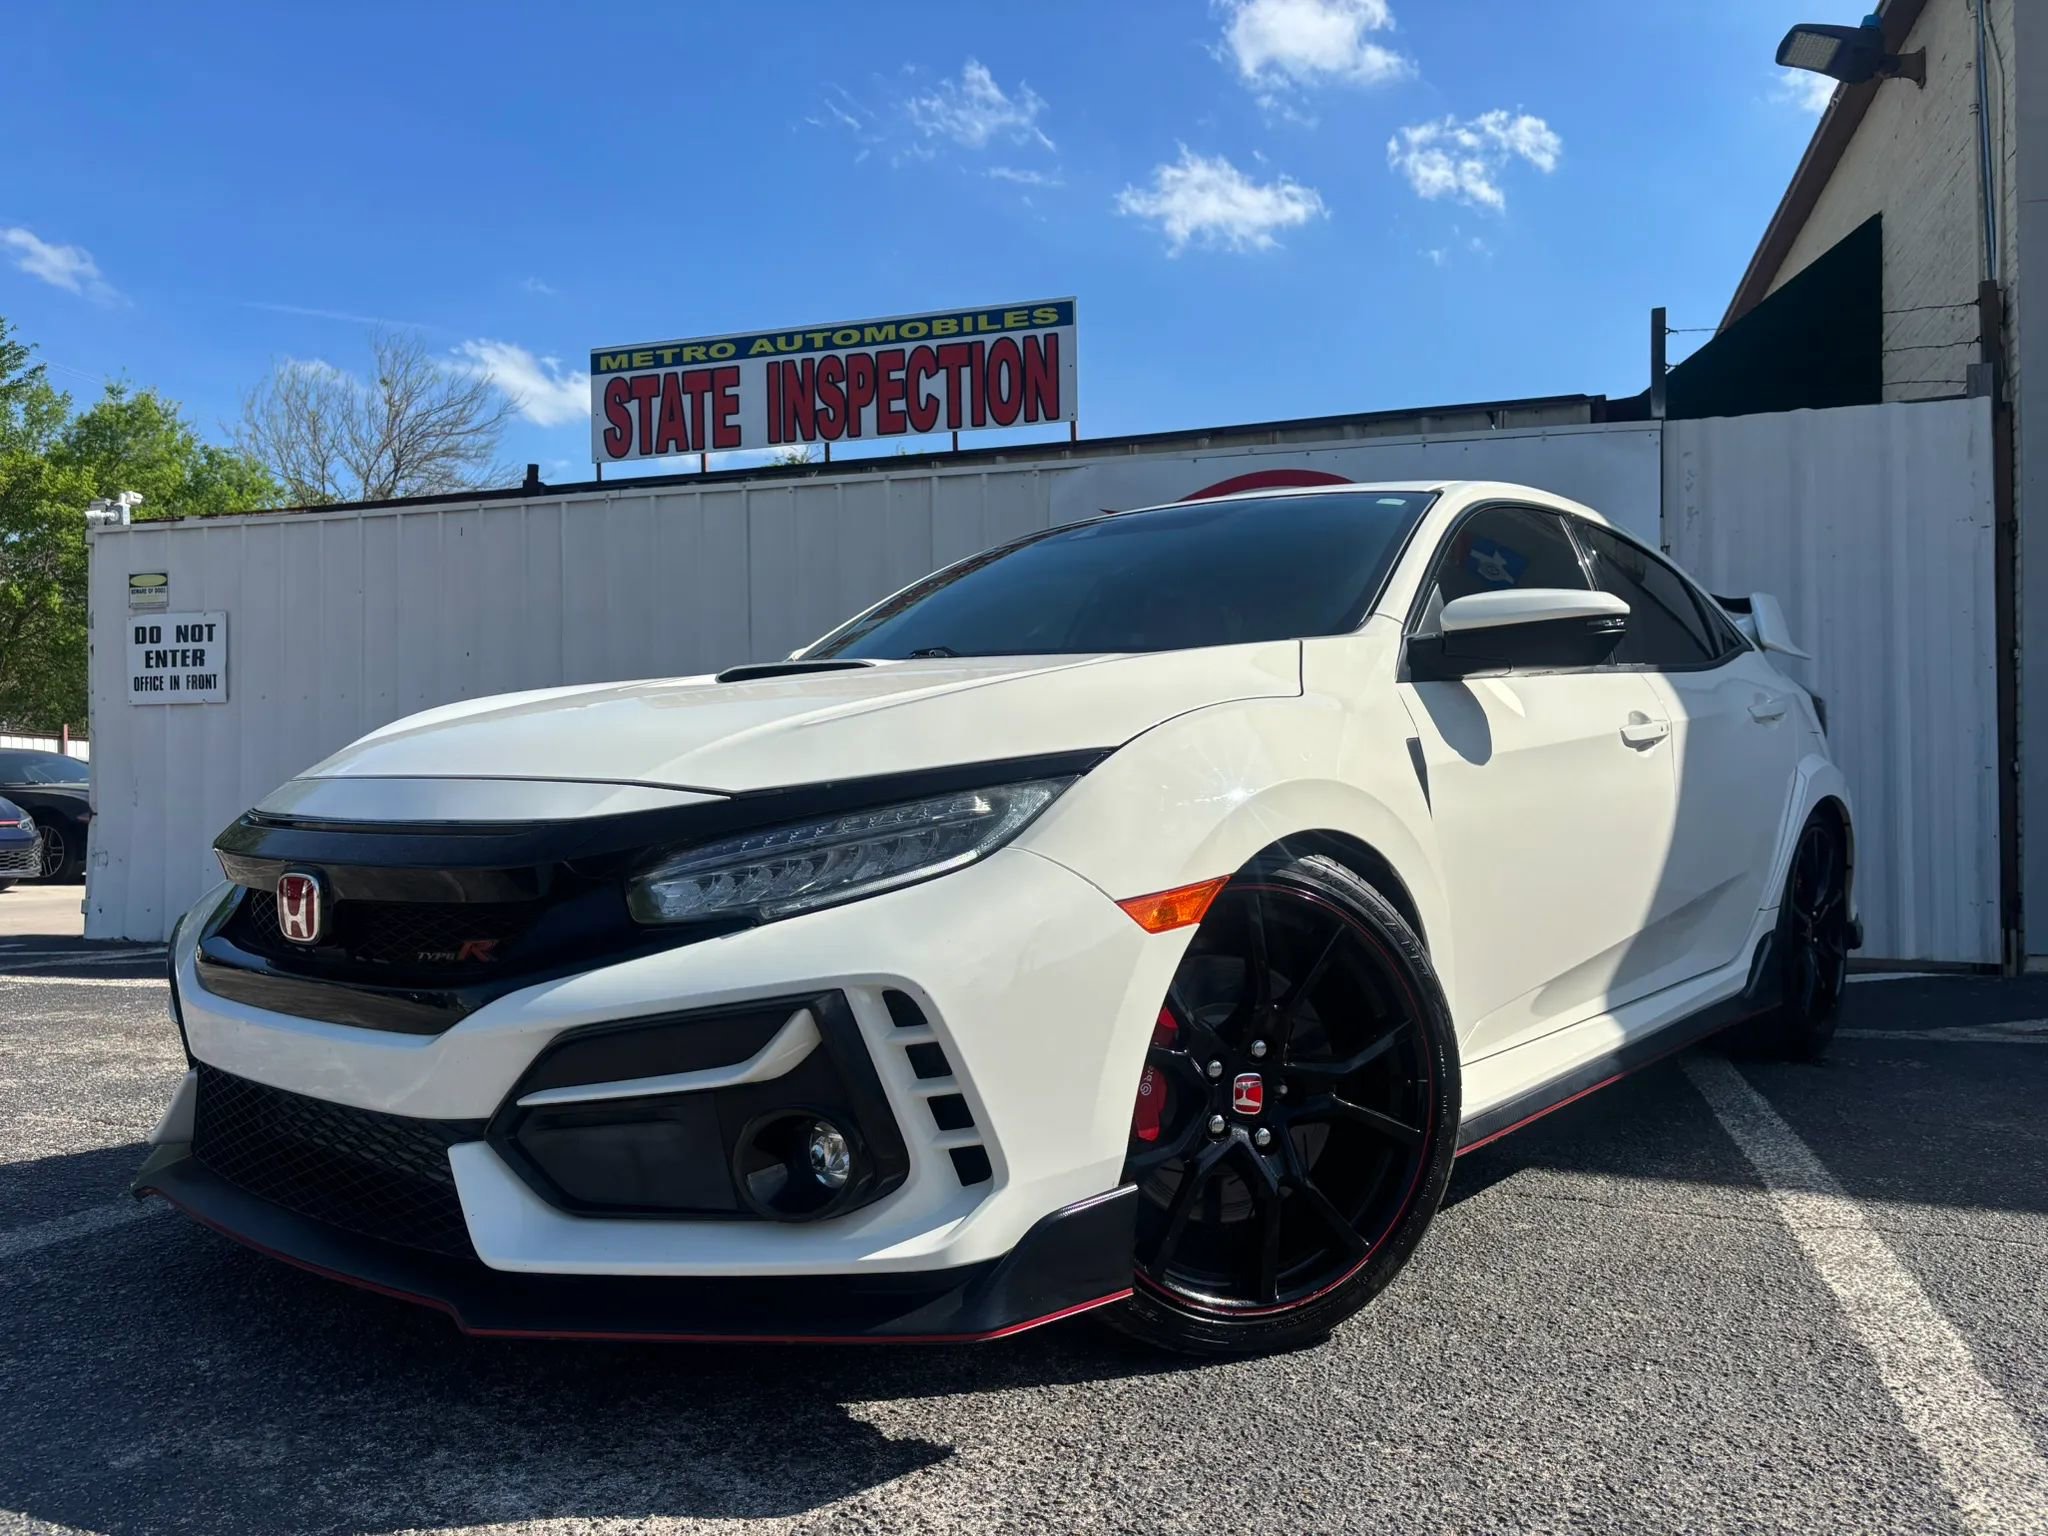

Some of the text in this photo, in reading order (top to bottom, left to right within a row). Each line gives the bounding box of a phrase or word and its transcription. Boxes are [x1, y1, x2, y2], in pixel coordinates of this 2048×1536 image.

[600, 307, 1060, 371] METRO AUTOMOBILES
[603, 332, 1061, 459] STATE INSPECTION
[134, 623, 217, 645] DO NOT
[145, 648, 206, 669] ENTER
[133, 674, 218, 692] OFFICE IN FRONT
[458, 938, 499, 962] R
